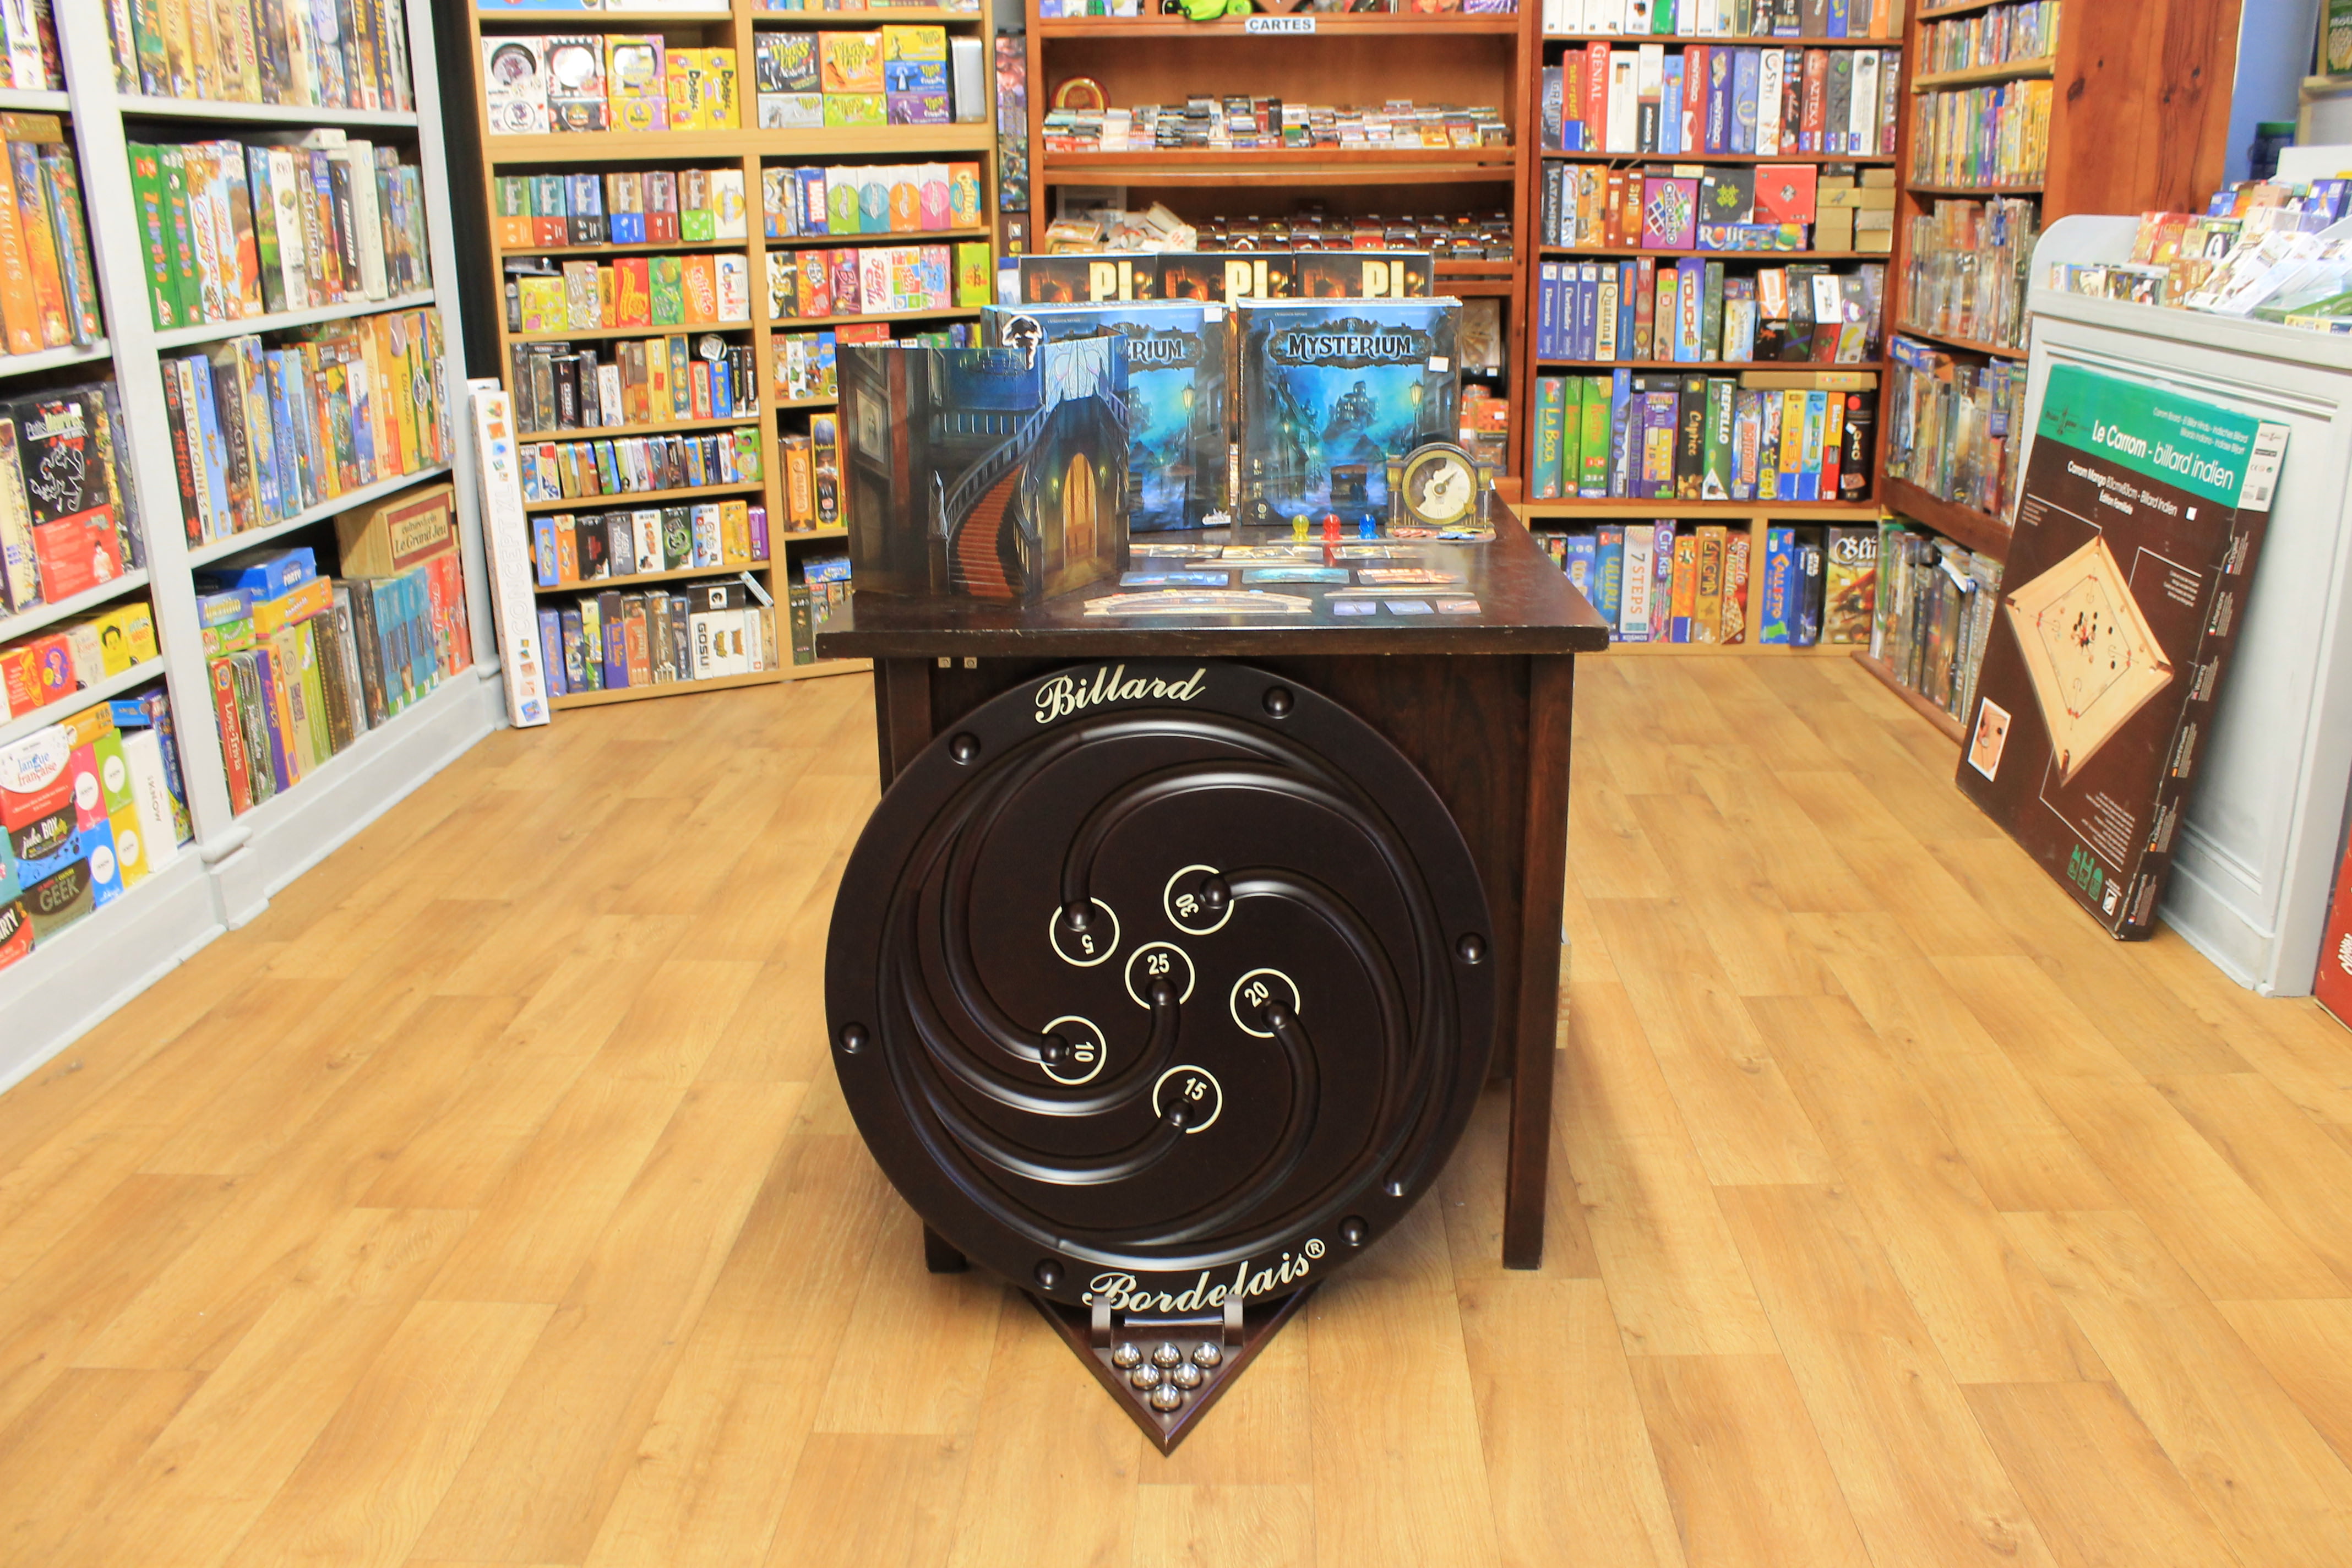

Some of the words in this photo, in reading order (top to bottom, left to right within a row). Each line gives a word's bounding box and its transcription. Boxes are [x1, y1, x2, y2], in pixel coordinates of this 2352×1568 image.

[1248, 19, 1311, 31] CARTES
[1809, 81, 1821, 127] AZTEKA
[809, 181, 826, 222] MARVEL
[1547, 167, 1561, 240] KATAMINO
[1663, 183, 1678, 244] CHROMINO
[1681, 271, 1698, 346] TOUCHÉ
[1288, 333, 1413, 362] MYSTERIUM
[1687, 410, 1702, 456] Caprice
[1718, 383, 1733, 444] REPELLO
[2091, 420, 2104, 443] Le
[2106, 425, 2148, 459] Carrom
[2153, 441, 2190, 476] billard
[2191, 455, 2235, 491] indien
[496, 518, 532, 636] CONCEPT
[1631, 553, 1646, 562] 7
[1700, 541, 1718, 596] ENIGMA
[1630, 565, 1645, 615] STEPS
[1771, 553, 1790, 619] CALLISTO
[696, 622, 710, 668] GOSU
[1035, 664, 1207, 724] Billard
[224, 700, 242, 772] Love-Trivia
[17, 761, 58, 788] française
[18, 752, 50, 778] langue
[39, 879, 80, 917] GEEK
[1174, 892, 1199, 918] 30
[1081, 934, 1095, 955] 5
[1146, 952, 1171, 976] 25
[1243, 980, 1270, 1008] 20
[1074, 1041, 1095, 1063] 10
[1183, 1076, 1208, 1101] 15
